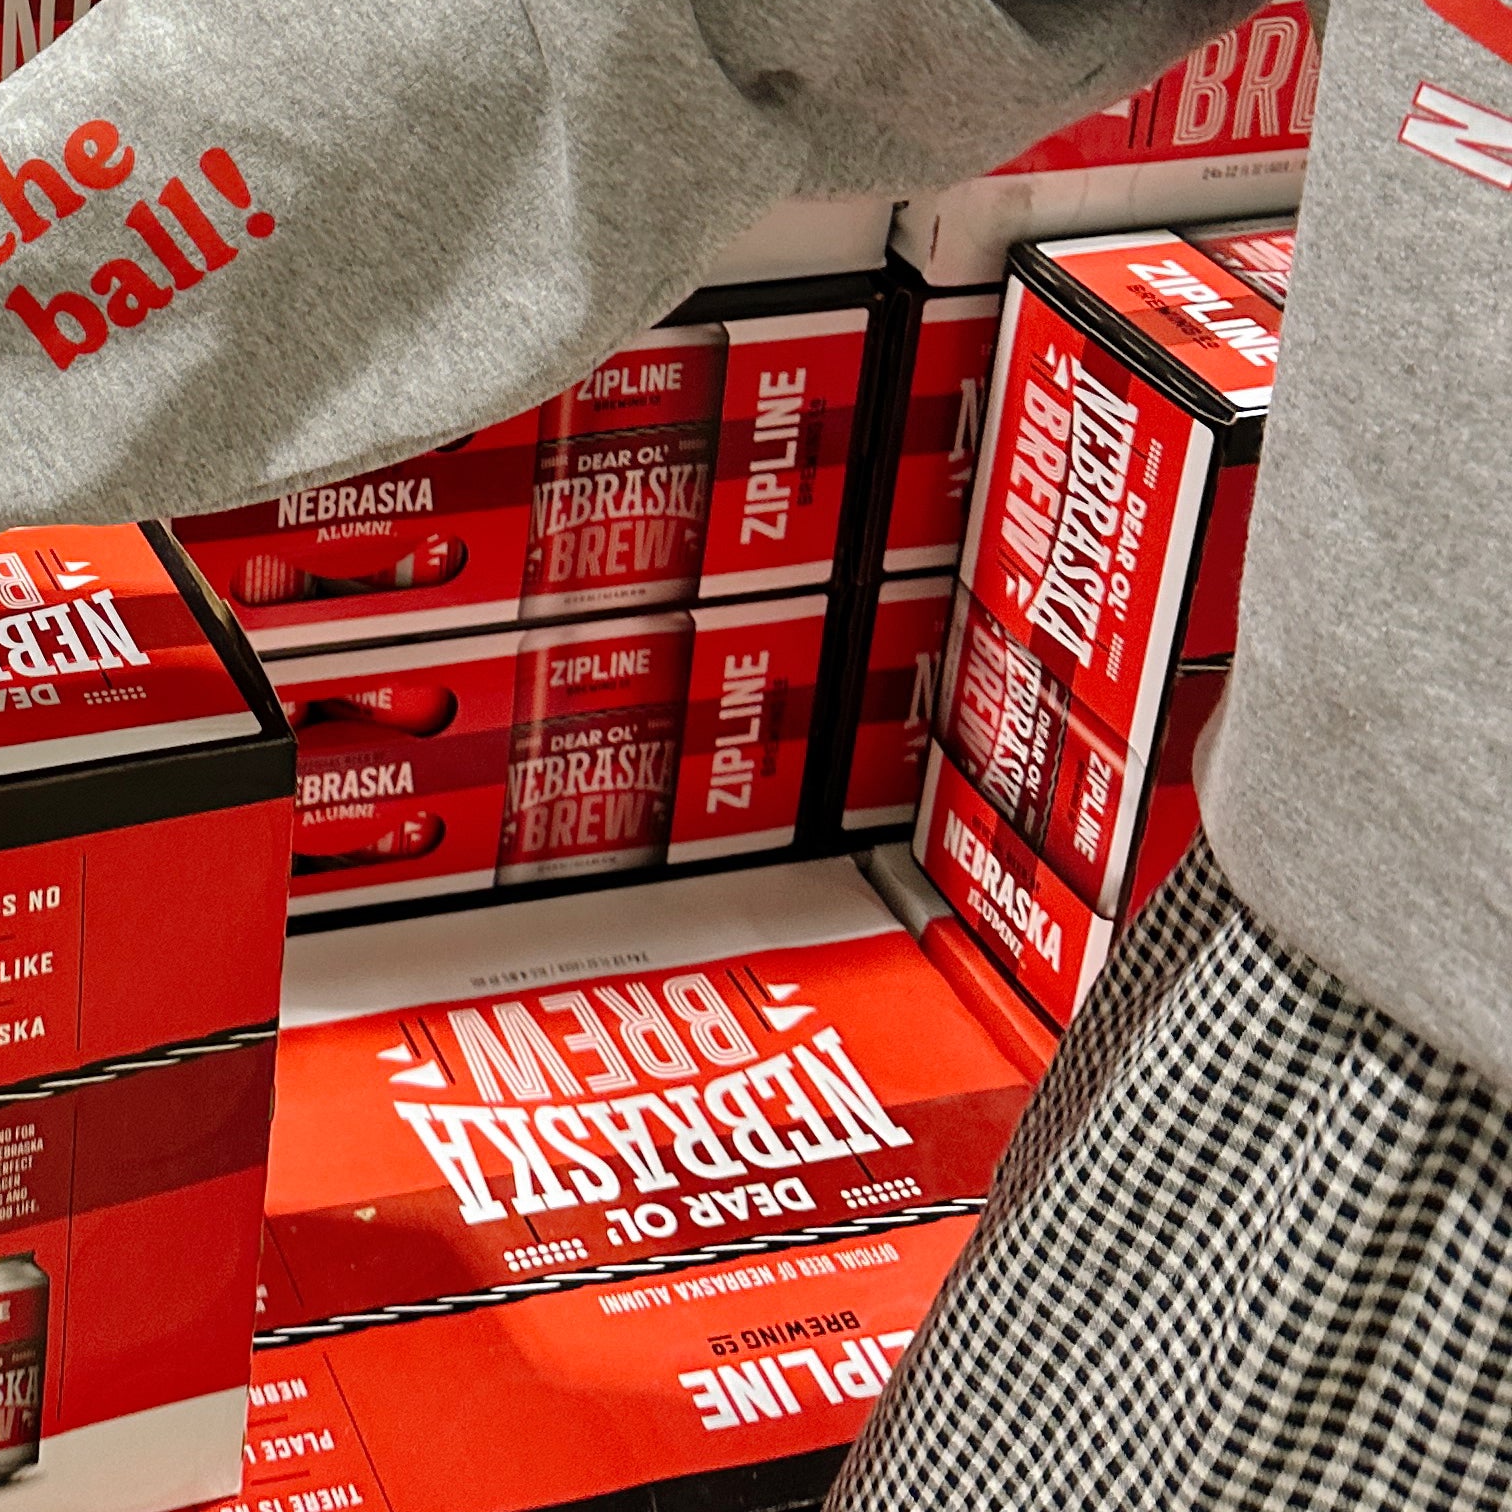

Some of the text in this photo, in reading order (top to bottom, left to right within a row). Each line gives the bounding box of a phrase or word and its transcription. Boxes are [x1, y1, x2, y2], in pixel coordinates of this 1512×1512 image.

[4, 147, 276, 371] ball!
[1126, 259, 1280, 367] ZIPLINE
[575, 361, 684, 402] ZIPLINE
[578, 448, 630, 472] DEAR
[740, 367, 807, 546] ZIPLINE
[999, 376, 1073, 585] BREW
[277, 476, 434, 529] NEBRASKA
[316, 520, 394, 544] ALUMNI
[530, 462, 709, 542] NEBRASKA
[1025, 351, 1142, 669] NEBRASKA
[548, 518, 678, 584] BREW
[1110, 489, 1149, 624] DEAR OL'
[549, 647, 652, 684] ZIPLINE
[956, 624, 1008, 773] BREW
[550, 730, 602, 752] DEAR
[706, 649, 770, 814] ZIPLINE
[1030, 707, 1052, 765] DEAR
[301, 803, 375, 827] ALUMNI
[503, 742, 674, 816] NEBRASKA
[1073, 750, 1113, 865] ZIPLINE
[521, 792, 645, 854] BREW
[26, 885, 62, 914] NO
[943, 807, 1063, 974] NEBRASKA
[446, 971, 759, 1106] BREW
[15, 1123, 36, 1141] FOR
[396, 1026, 915, 1226] NEBRASKA
[5, 1185, 28, 1204] AND
[605, 1175, 815, 1248] DEAR OL'
[597, 1241, 900, 1316] OFFICIAL BEER OF NEBRASKA ALUMNI
[740, 1310, 861, 1351] BREWING
[260, 1428, 336, 1462] PLACE
